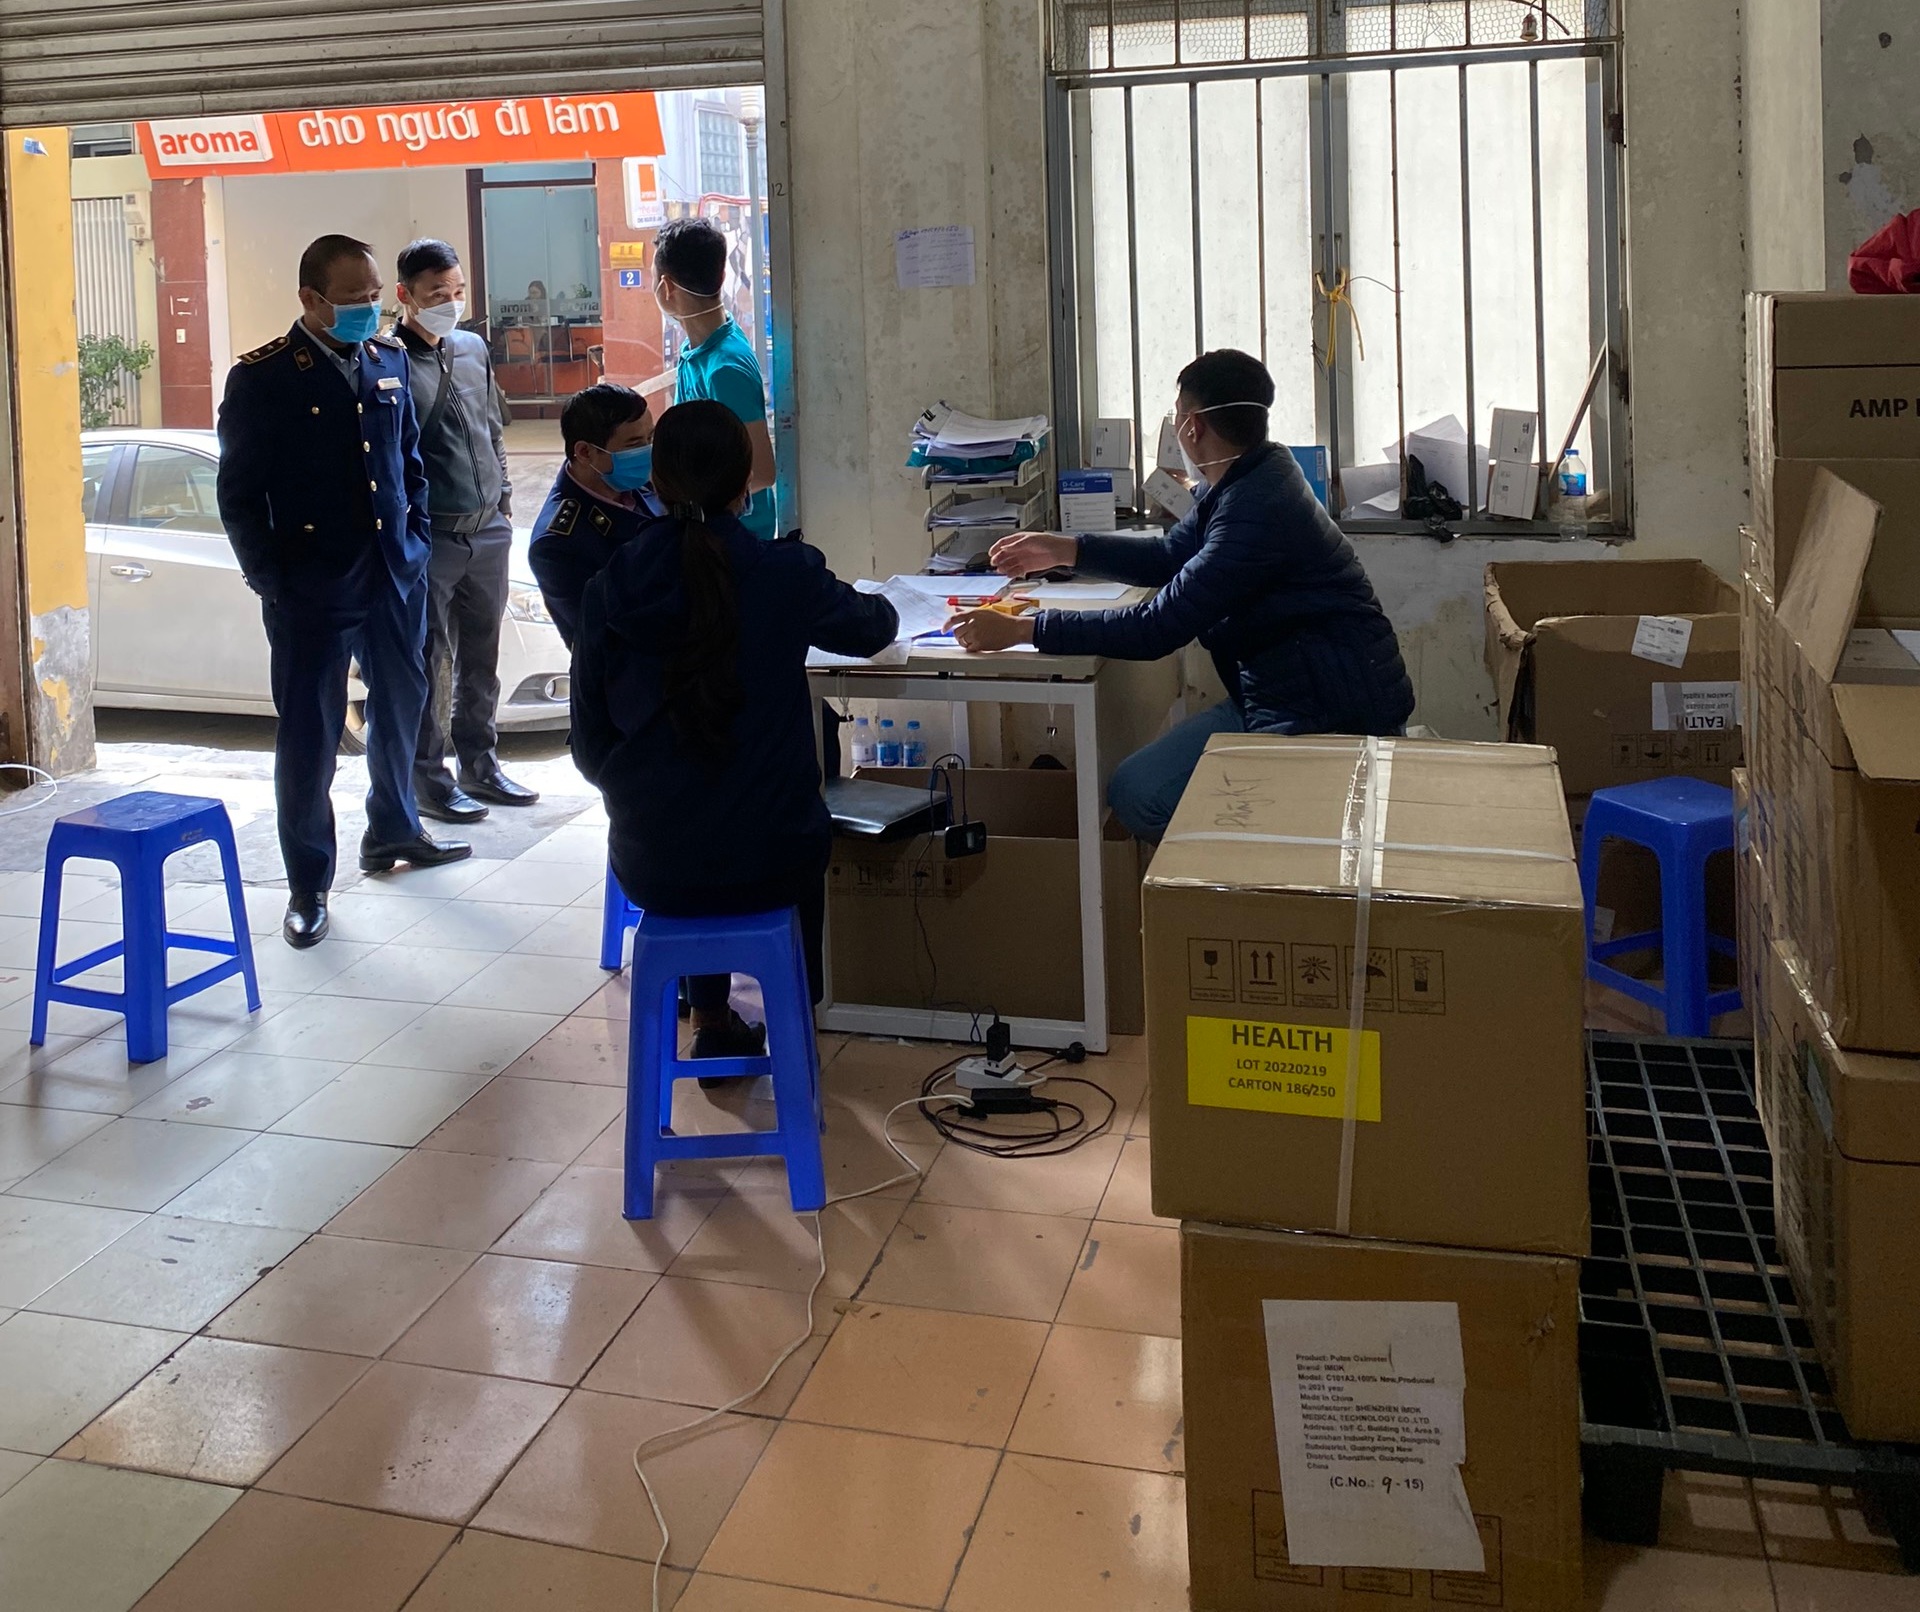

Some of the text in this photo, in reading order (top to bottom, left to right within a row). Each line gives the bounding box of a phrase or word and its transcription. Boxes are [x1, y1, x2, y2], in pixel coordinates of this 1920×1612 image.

[298, 110, 366, 147] cho
[494, 99, 531, 136] đi
[159, 129, 259, 155] aroma
[771, 178, 786, 198] 12
[626, 271, 635, 285] 2
[500, 303, 539, 313] aroma
[1849, 398, 1909, 418] AMP
[1231, 1023, 1333, 1053] HEALTH
[1236, 1058, 1327, 1077] LOT 20220219
[1228, 1077, 1336, 1098] CARTON 186/250
[1382, 1476, 1393, 1495] 9
[1404, 1478, 1425, 1492] 15)
